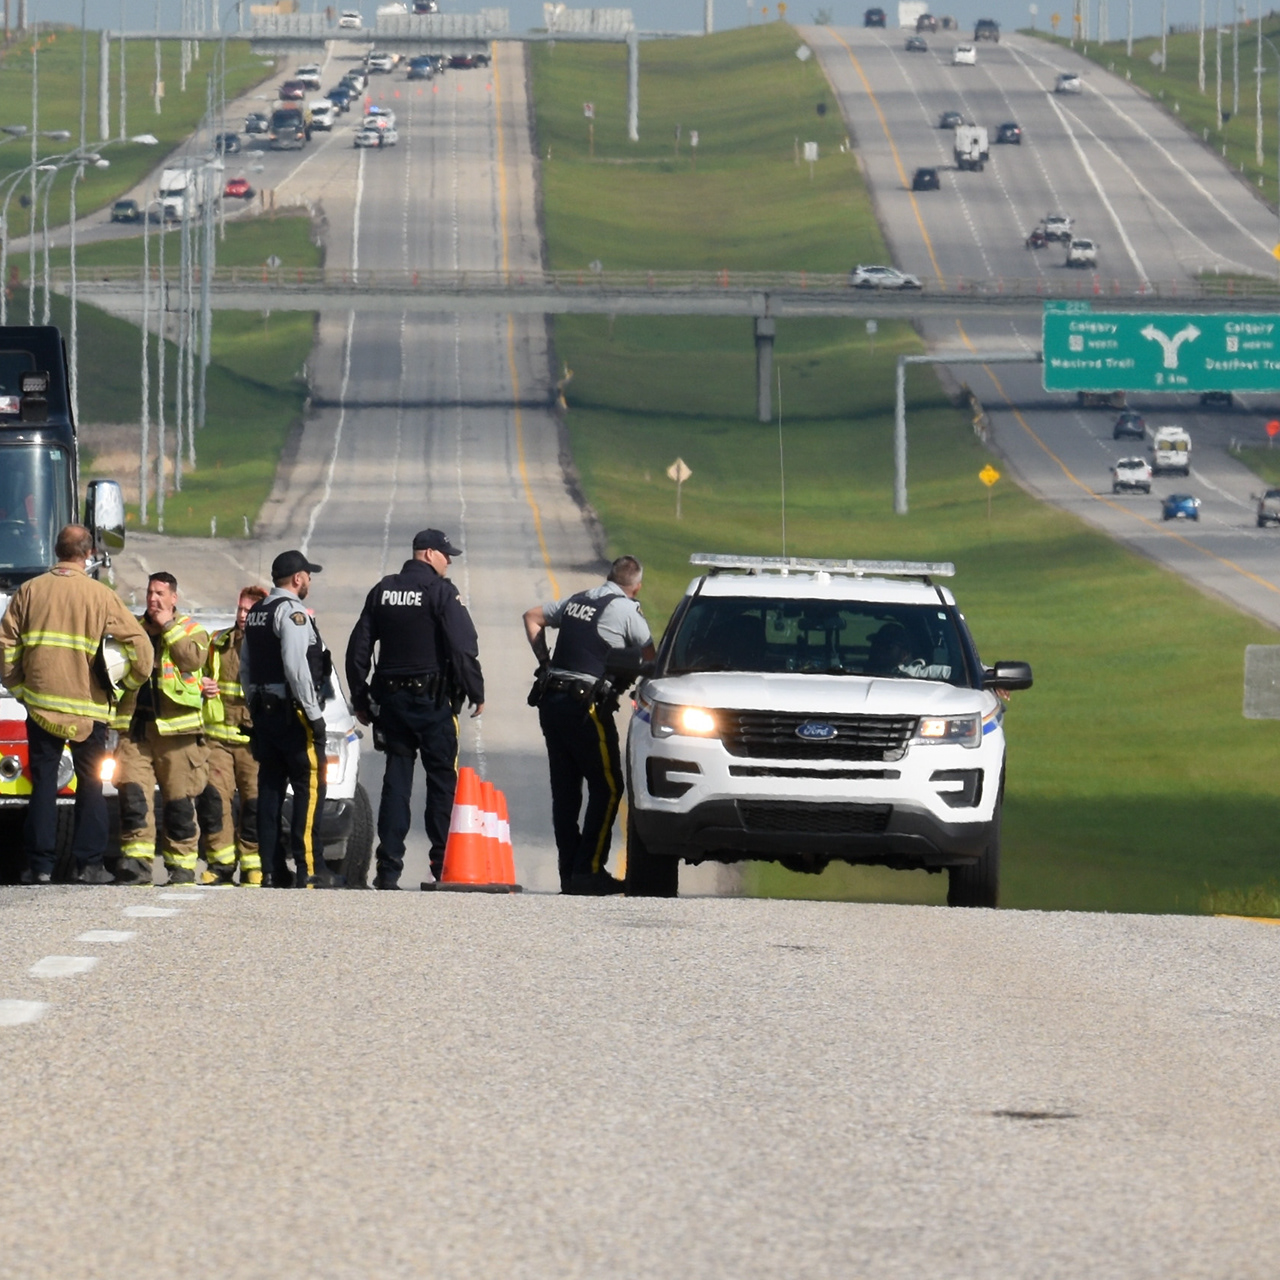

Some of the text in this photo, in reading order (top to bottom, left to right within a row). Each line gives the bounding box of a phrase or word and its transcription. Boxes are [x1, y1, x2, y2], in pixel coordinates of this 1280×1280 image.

[381, 590, 422, 606] POLICE
[563, 601, 597, 621] POLICE
[803, 724, 829, 735] Ford
